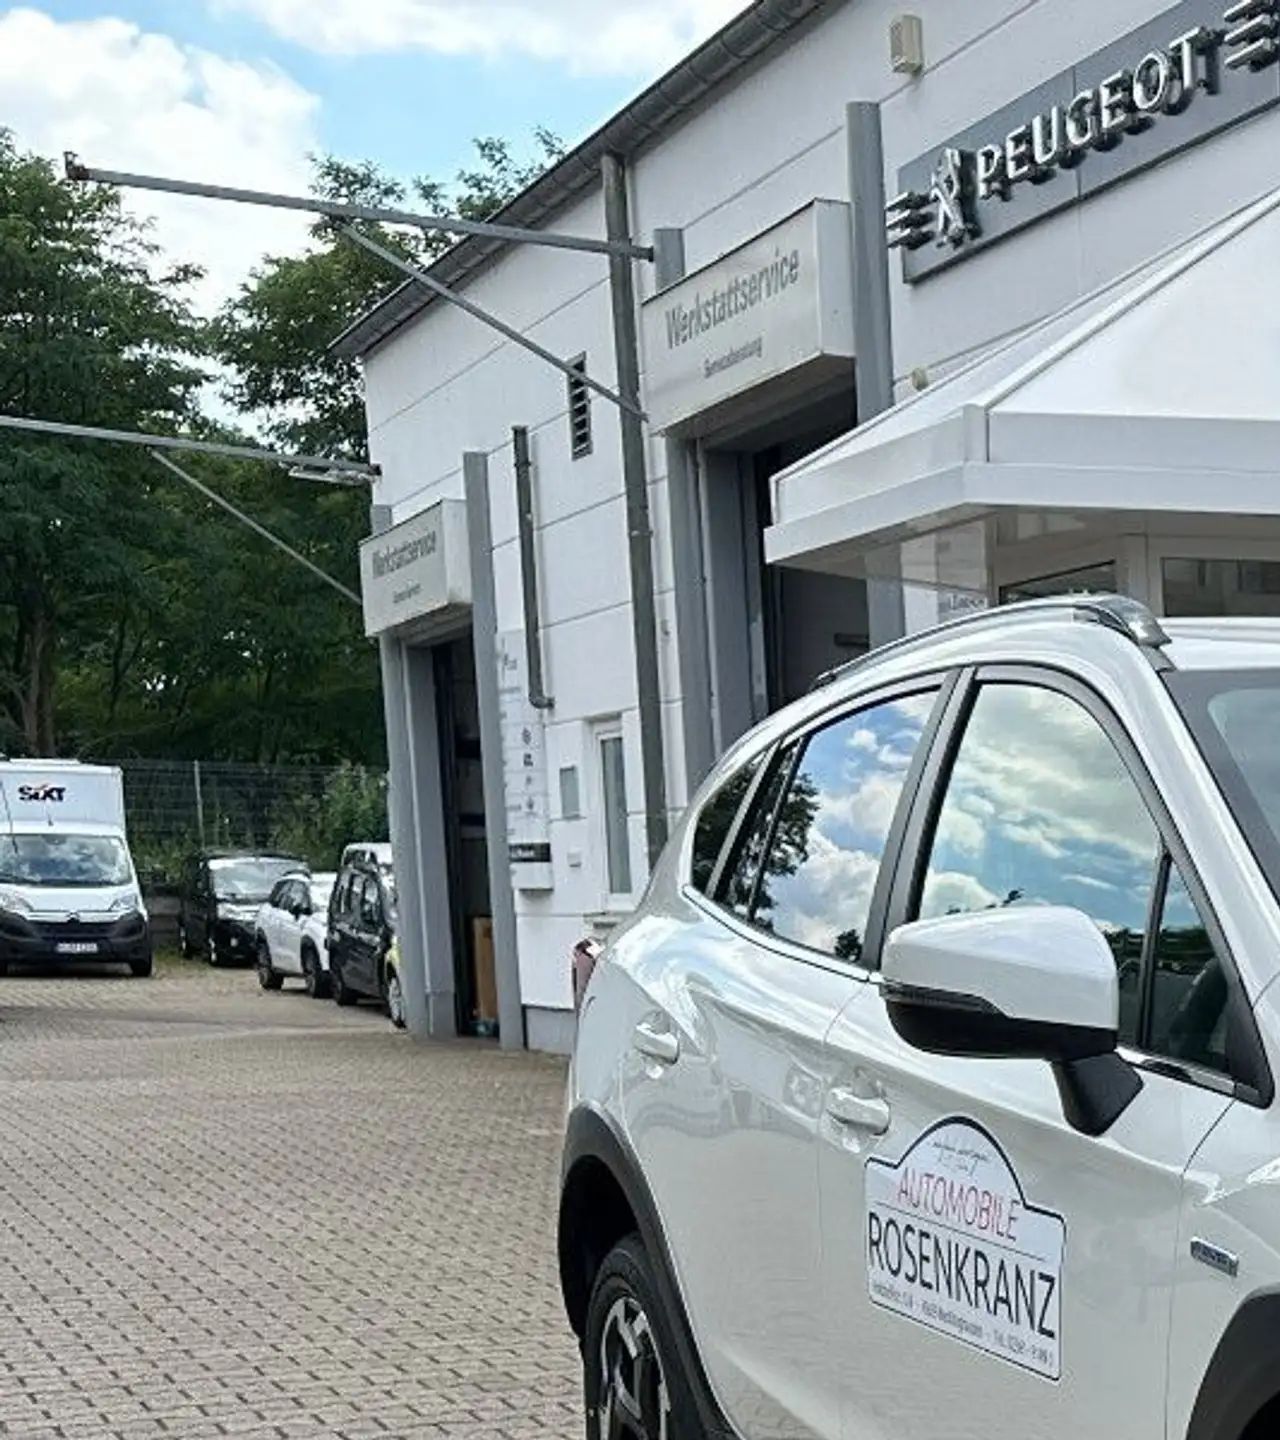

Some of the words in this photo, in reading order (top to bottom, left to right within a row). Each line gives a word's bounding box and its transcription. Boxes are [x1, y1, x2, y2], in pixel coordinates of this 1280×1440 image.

[976, 26, 1203, 200] PEUGEOT
[665, 247, 800, 350] Werkstattservice
[897, 1166, 1021, 1242] AUTOMOBILE
[868, 1210, 1056, 1341] ROSENKRANZ
